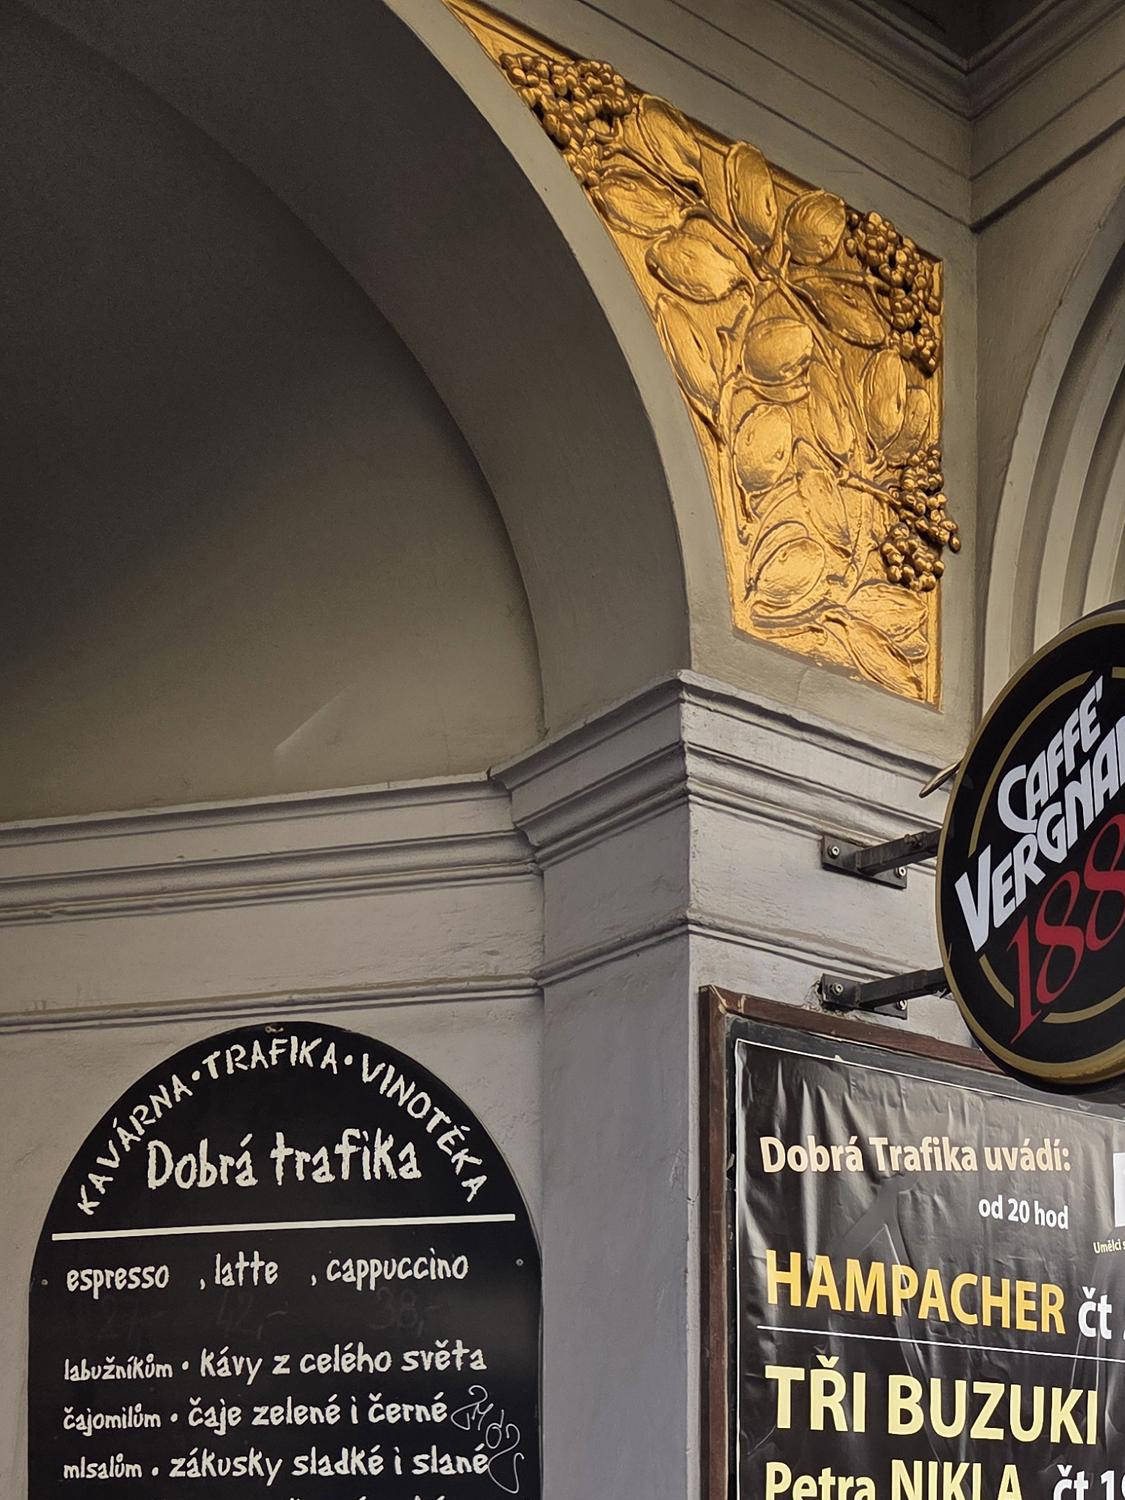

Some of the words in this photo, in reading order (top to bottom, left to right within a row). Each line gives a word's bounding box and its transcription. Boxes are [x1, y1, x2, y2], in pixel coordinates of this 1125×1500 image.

[78, 1073, 192, 1214] KAVÁRNA
[203, 1036, 339, 1079] TRAFIKA
[361, 1053, 488, 1202] VINOTÉKA
[147, 1134, 258, 1189] Dobrá
[270, 1128, 421, 1185] trafika
[760, 1137, 863, 1172] Dobrá
[869, 1137, 978, 1172] Trafika
[984, 1138, 1070, 1171] uvádí:
[979, 1195, 1003, 1219] od
[1008, 1198, 1029, 1223] 20
[1034, 1201, 1068, 1229] hod
[1093, 1238, 1121, 1253] Umělci
[67, 1265, 169, 1299] espresso
[327, 1248, 468, 1291] cappuccino
[766, 1250, 1066, 1334] HAMPACHER
[1078, 1287, 1112, 1339] čt
[65, 1354, 172, 1381] labužníkům
[272, 1355, 290, 1374] z
[300, 1342, 392, 1373] celého
[401, 1340, 487, 1371] světa
[64, 1403, 161, 1436] čajomilům
[189, 1397, 241, 1435] čaje
[252, 1394, 340, 1425] zelené
[351, 1396, 358, 1424] i
[368, 1392, 447, 1423] černé
[765, 1355, 865, 1432] TŘI
[888, 1374, 1097, 1445] BUZUKI
[64, 1453, 142, 1479] mlsalům
[169, 1448, 282, 1486] zákusky
[292, 1445, 384, 1476] sladké
[394, 1447, 402, 1475] i
[413, 1444, 488, 1476] slané
